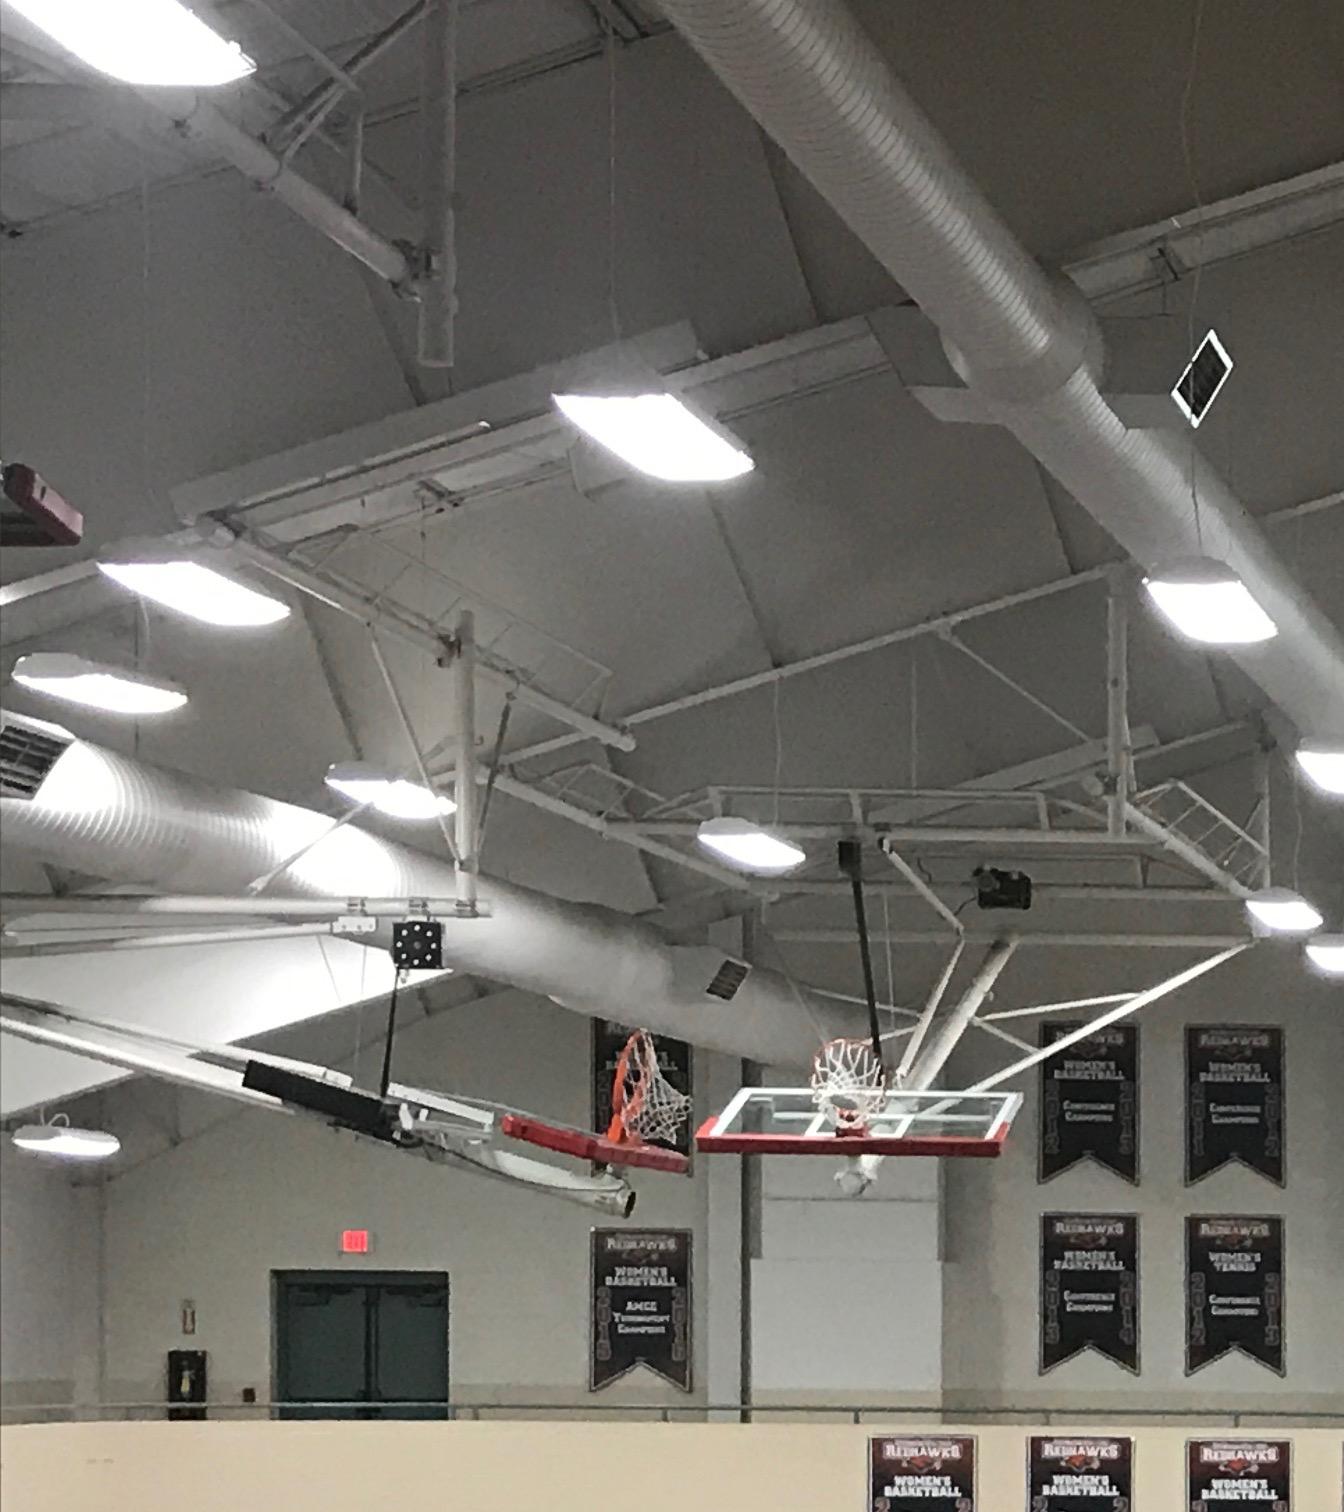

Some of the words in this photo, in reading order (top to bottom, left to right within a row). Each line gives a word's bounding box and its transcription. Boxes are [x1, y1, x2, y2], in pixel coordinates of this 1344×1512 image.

[884, 1486, 961, 1497] BASKETBALL
[1042, 1485, 1119, 1496] BASKETBALL
[1202, 1490, 1278, 1500] BASKETBALL
